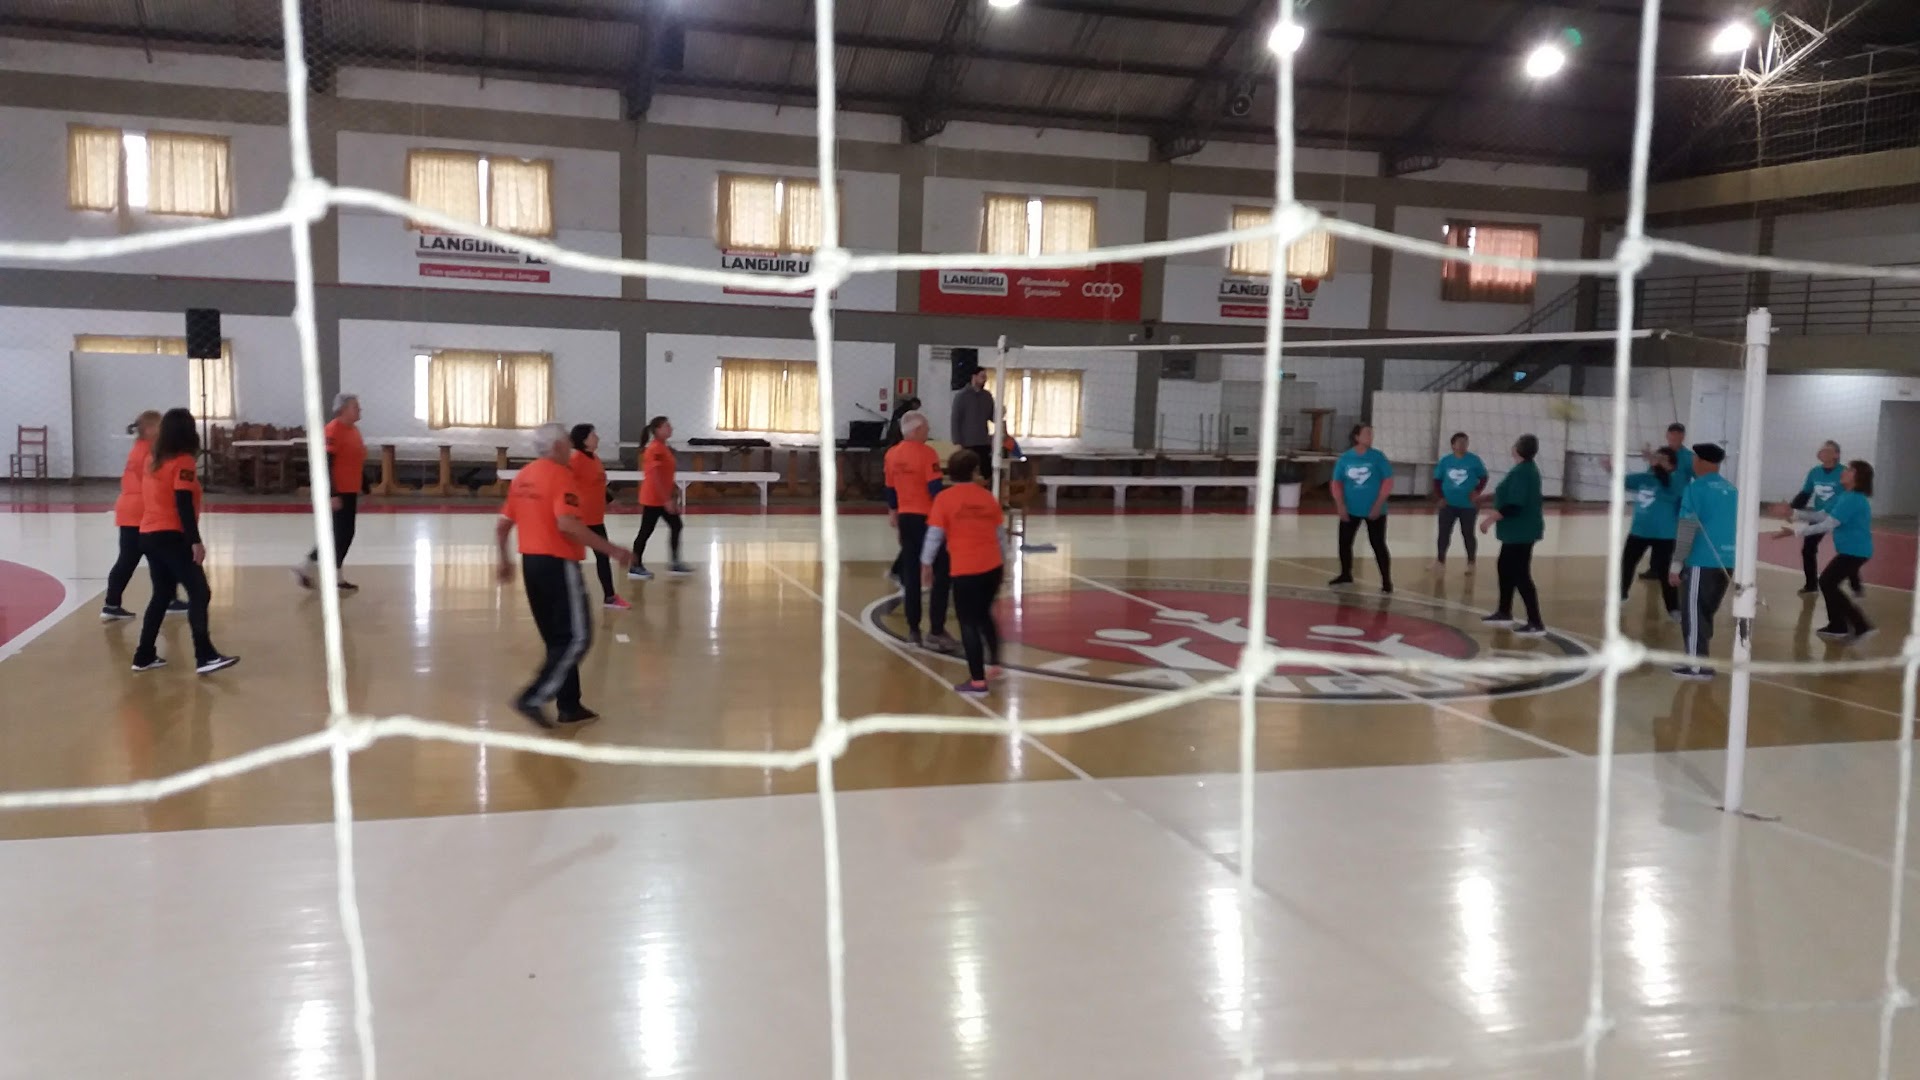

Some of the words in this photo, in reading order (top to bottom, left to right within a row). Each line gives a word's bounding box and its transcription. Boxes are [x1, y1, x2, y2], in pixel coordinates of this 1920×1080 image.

[721, 256, 810, 274] LANGUIRU
[943, 274, 1005, 287] LANGUIRU
[1220, 282, 1293, 297] LANGUU
